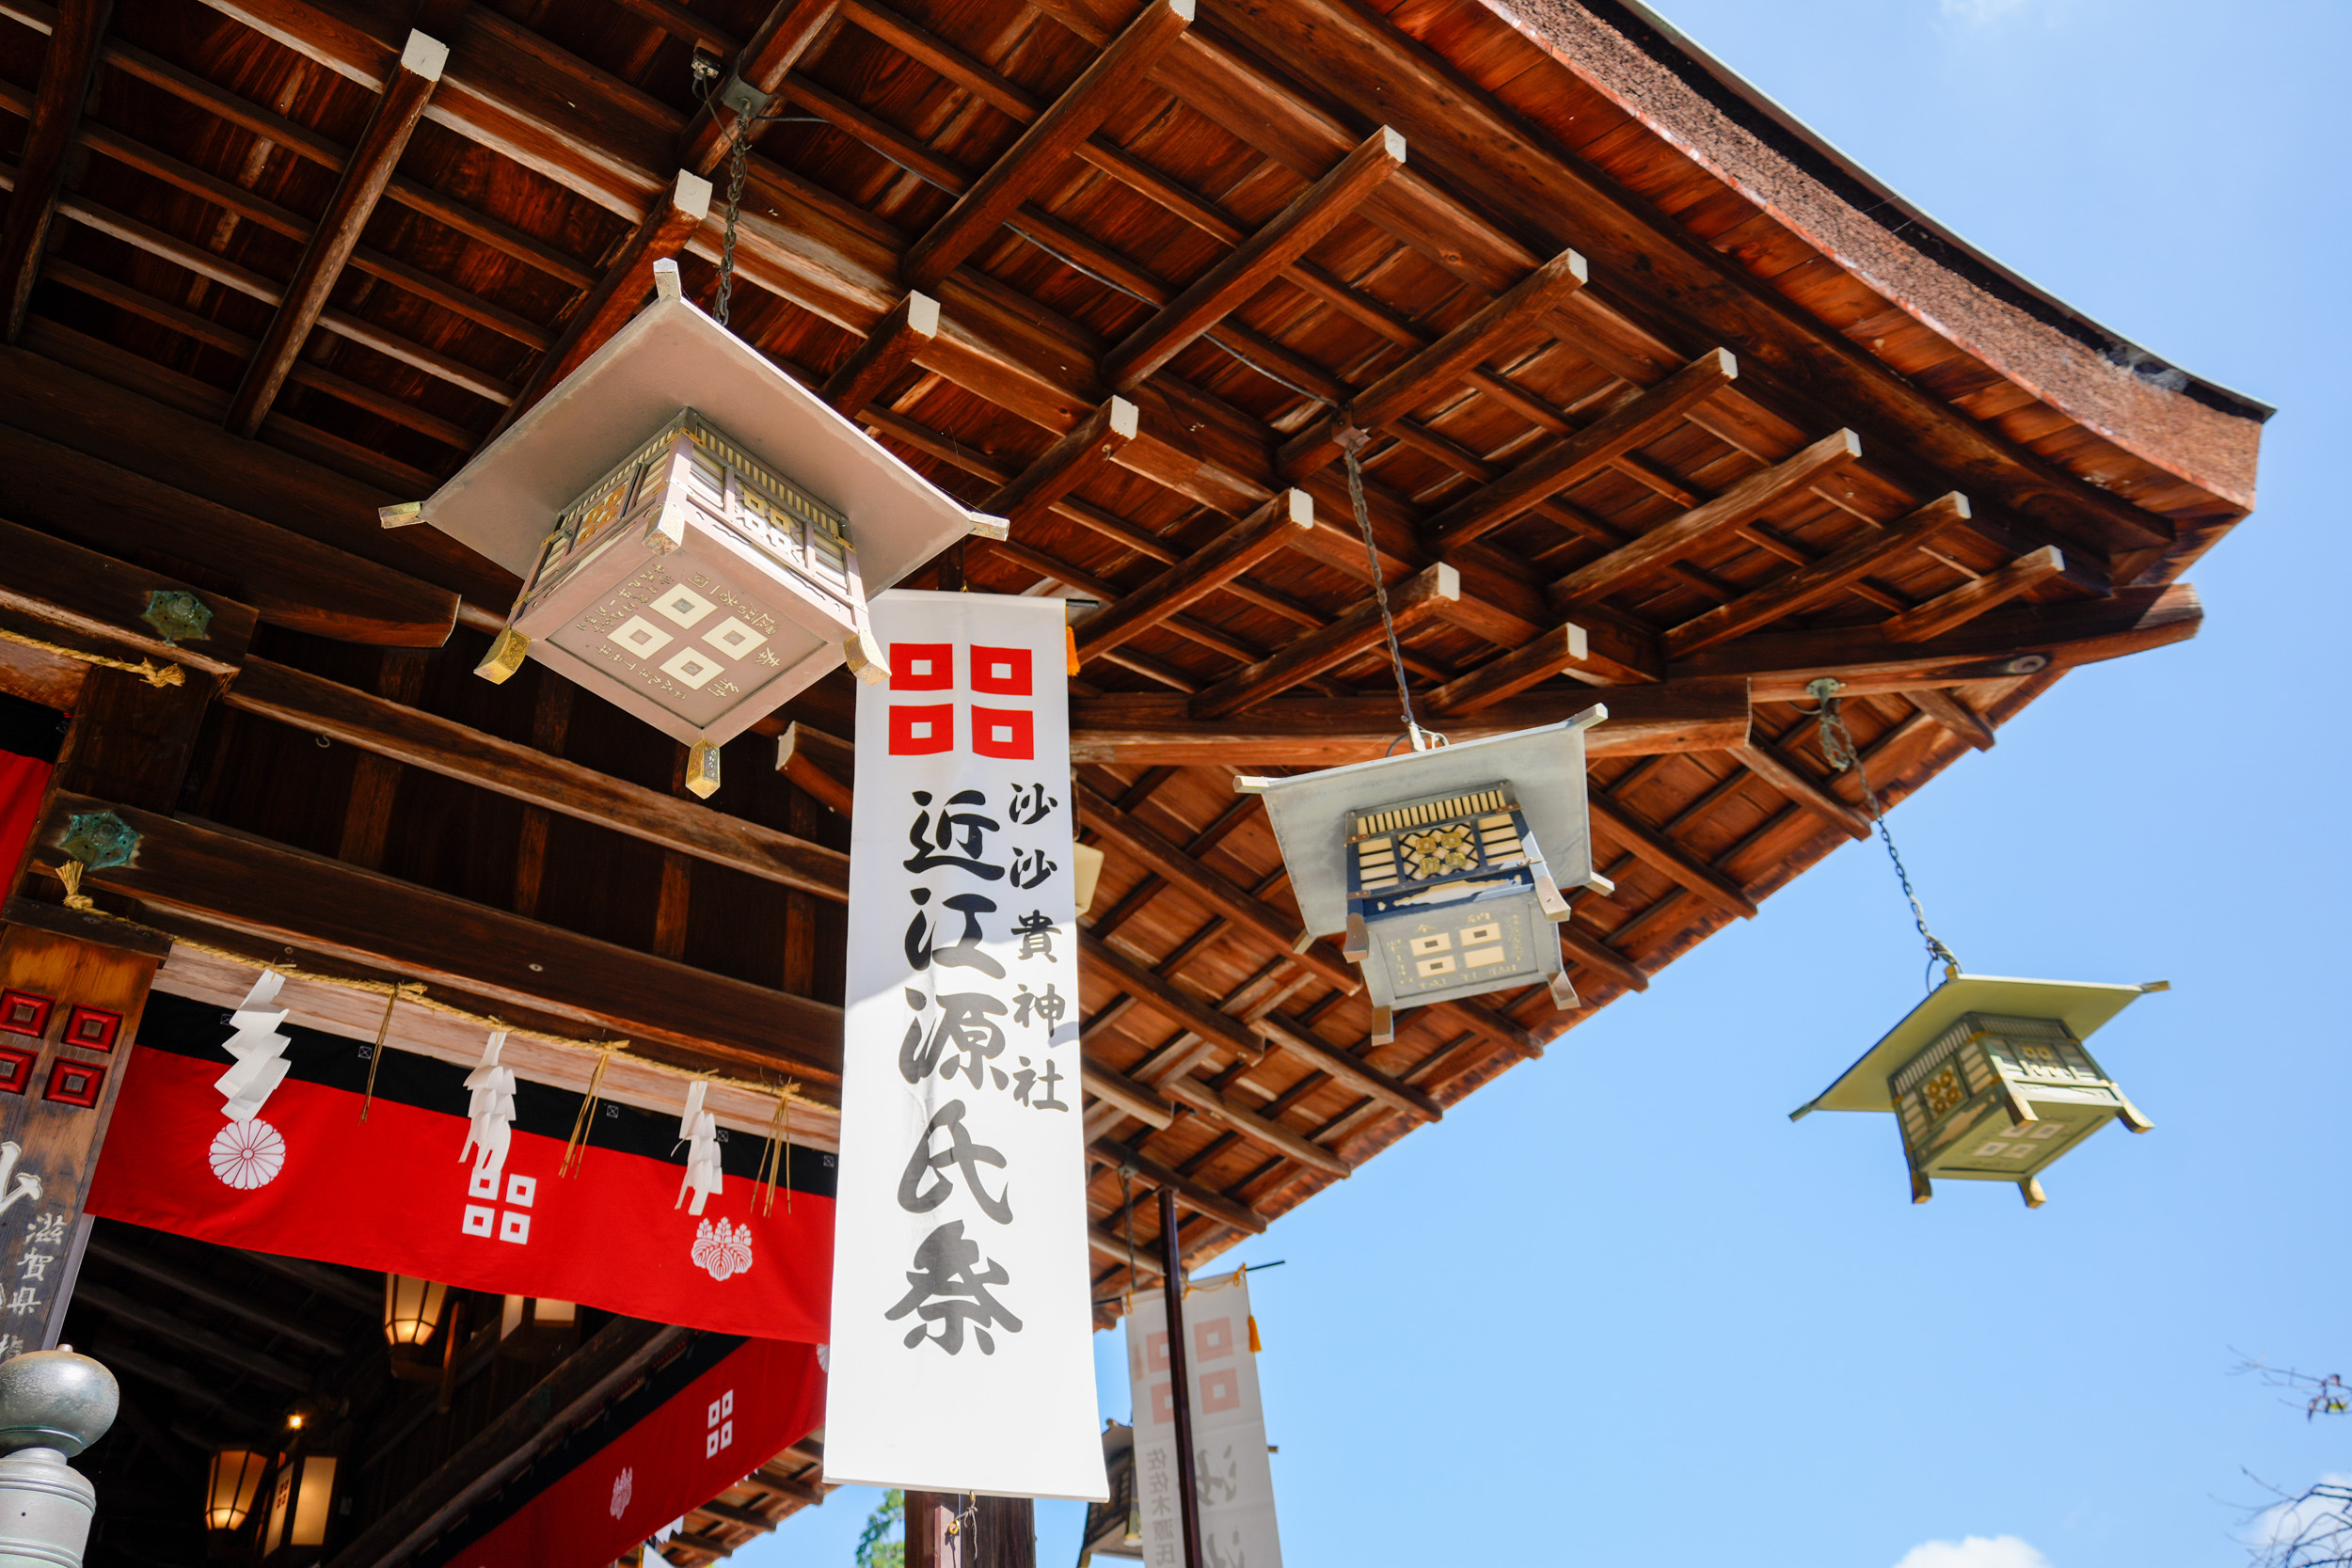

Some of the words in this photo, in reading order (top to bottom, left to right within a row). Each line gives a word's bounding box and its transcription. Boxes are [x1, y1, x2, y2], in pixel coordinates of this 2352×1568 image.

[884, 789, 1024, 1356] 近江源氏祭
[1009, 782, 1070, 1113] 沙沙貴神社
